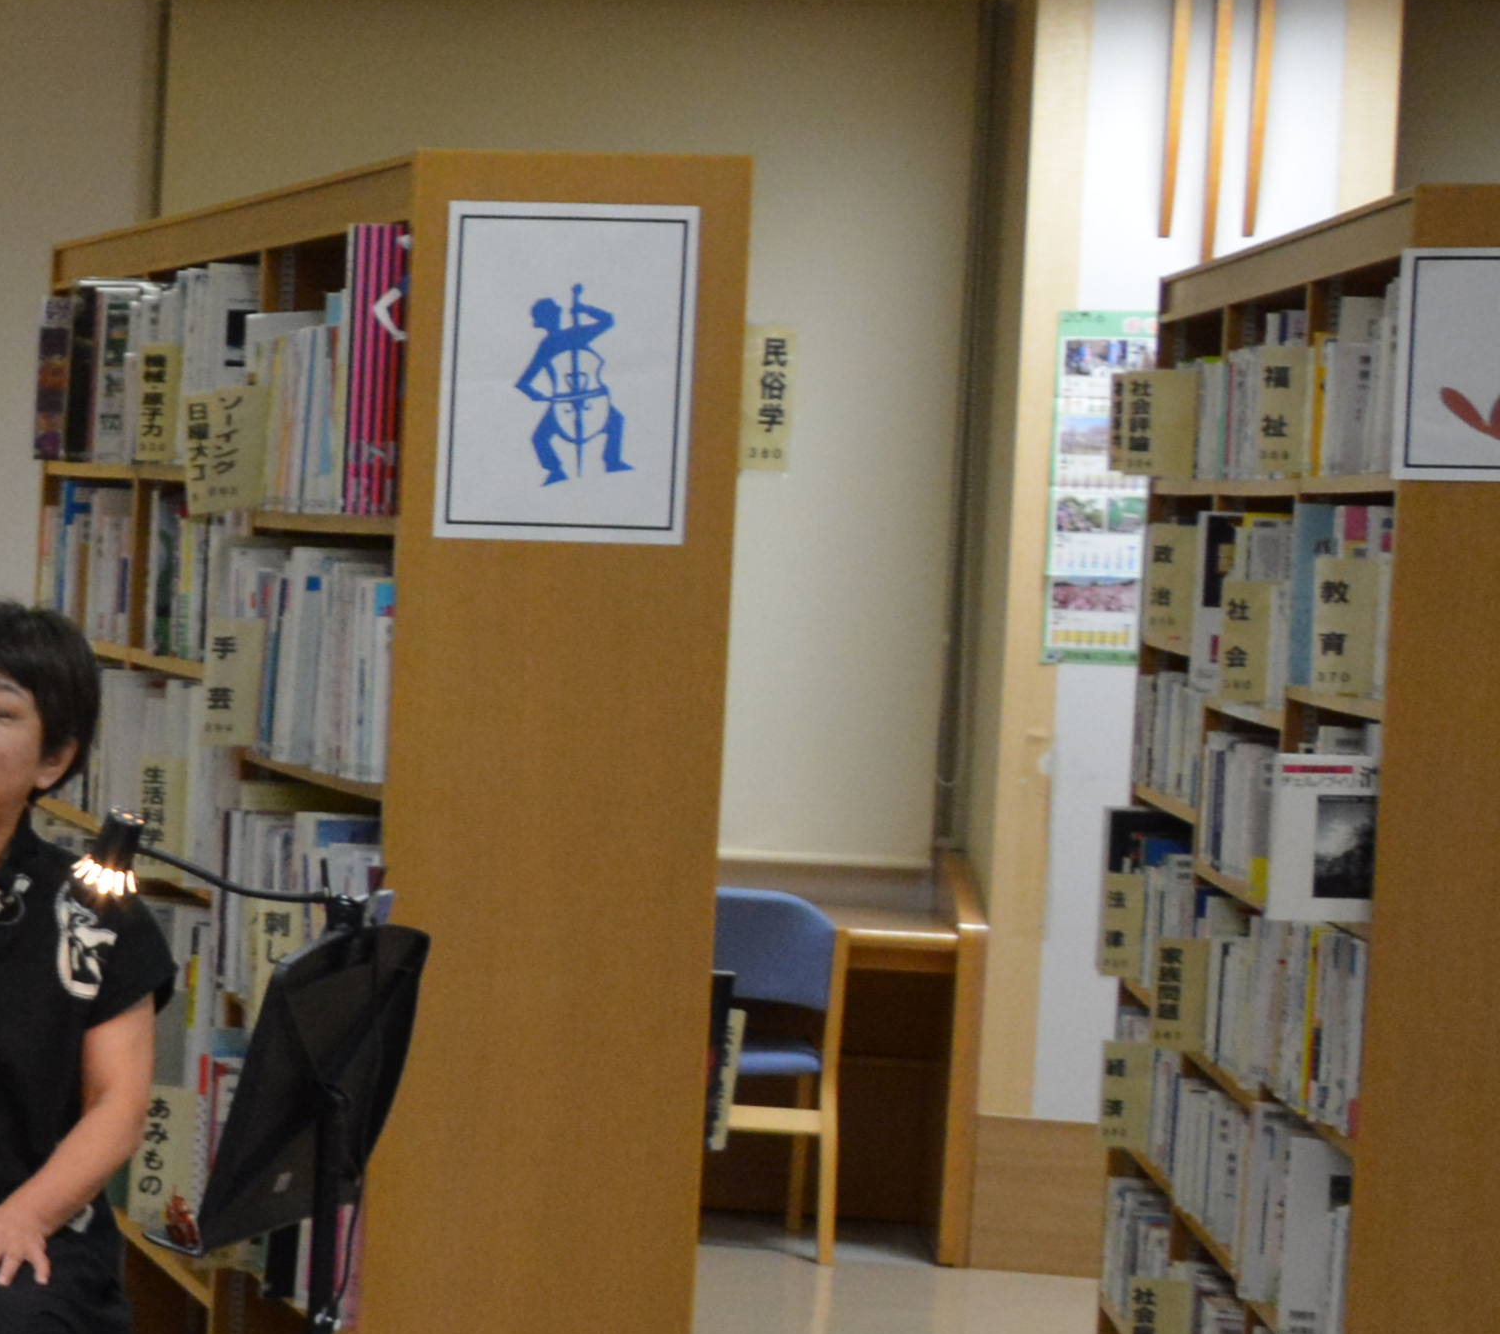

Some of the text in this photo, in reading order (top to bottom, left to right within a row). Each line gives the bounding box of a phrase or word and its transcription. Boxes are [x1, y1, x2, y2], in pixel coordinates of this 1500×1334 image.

[139, 353, 167, 438] 機械・原子力
[757, 336, 788, 434] 民俗学
[1128, 379, 1153, 453] 社会評論
[1262, 365, 1291, 439] 福祉
[211, 395, 243, 476] ソーイング
[1151, 543, 1175, 608] 政治
[1225, 598, 1251, 668] 社会
[1319, 579, 1351, 656] 教育
[207, 635, 237, 711] 手芸
[136, 1097, 171, 1197] あみもの
